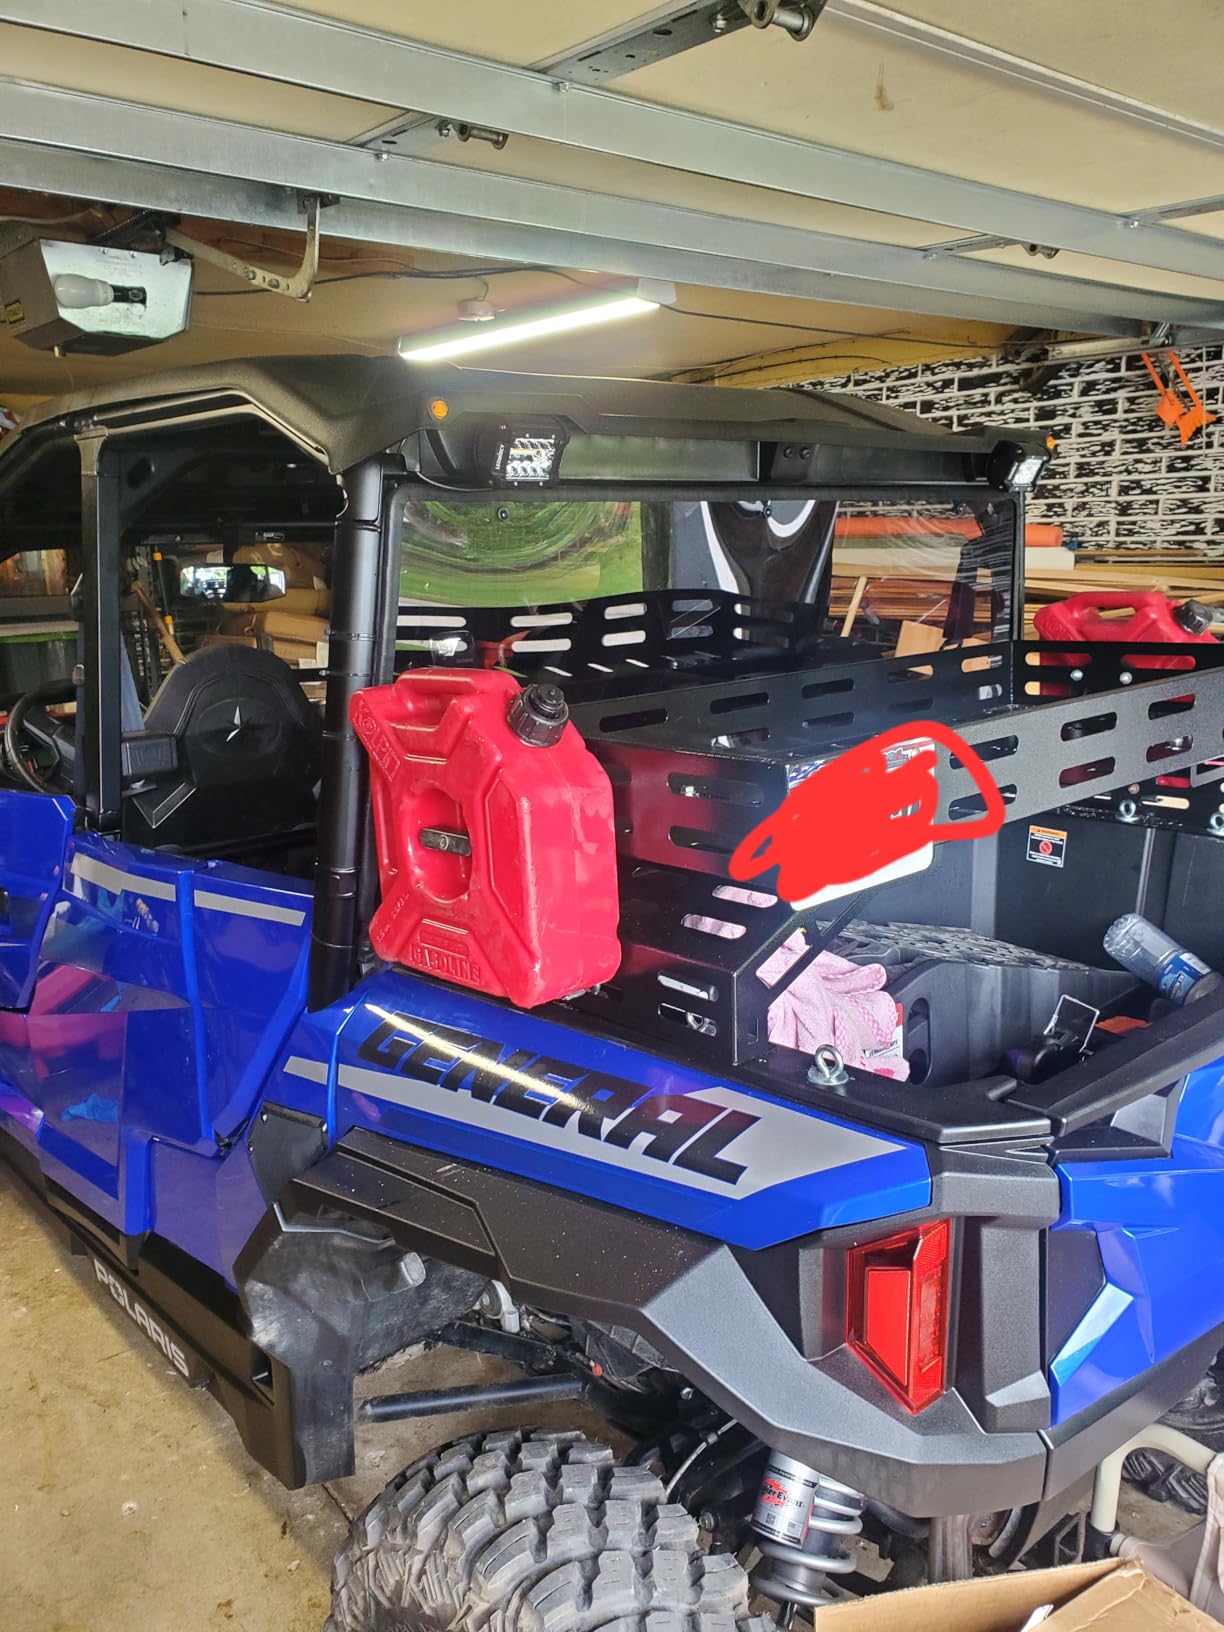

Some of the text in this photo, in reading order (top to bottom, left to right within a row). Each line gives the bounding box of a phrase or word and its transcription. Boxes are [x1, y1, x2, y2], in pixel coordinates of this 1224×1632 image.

[409, 944, 481, 985] GASOLINE
[359, 1012, 763, 1185] GENERAL
[94, 1258, 189, 1376] POLARIS
